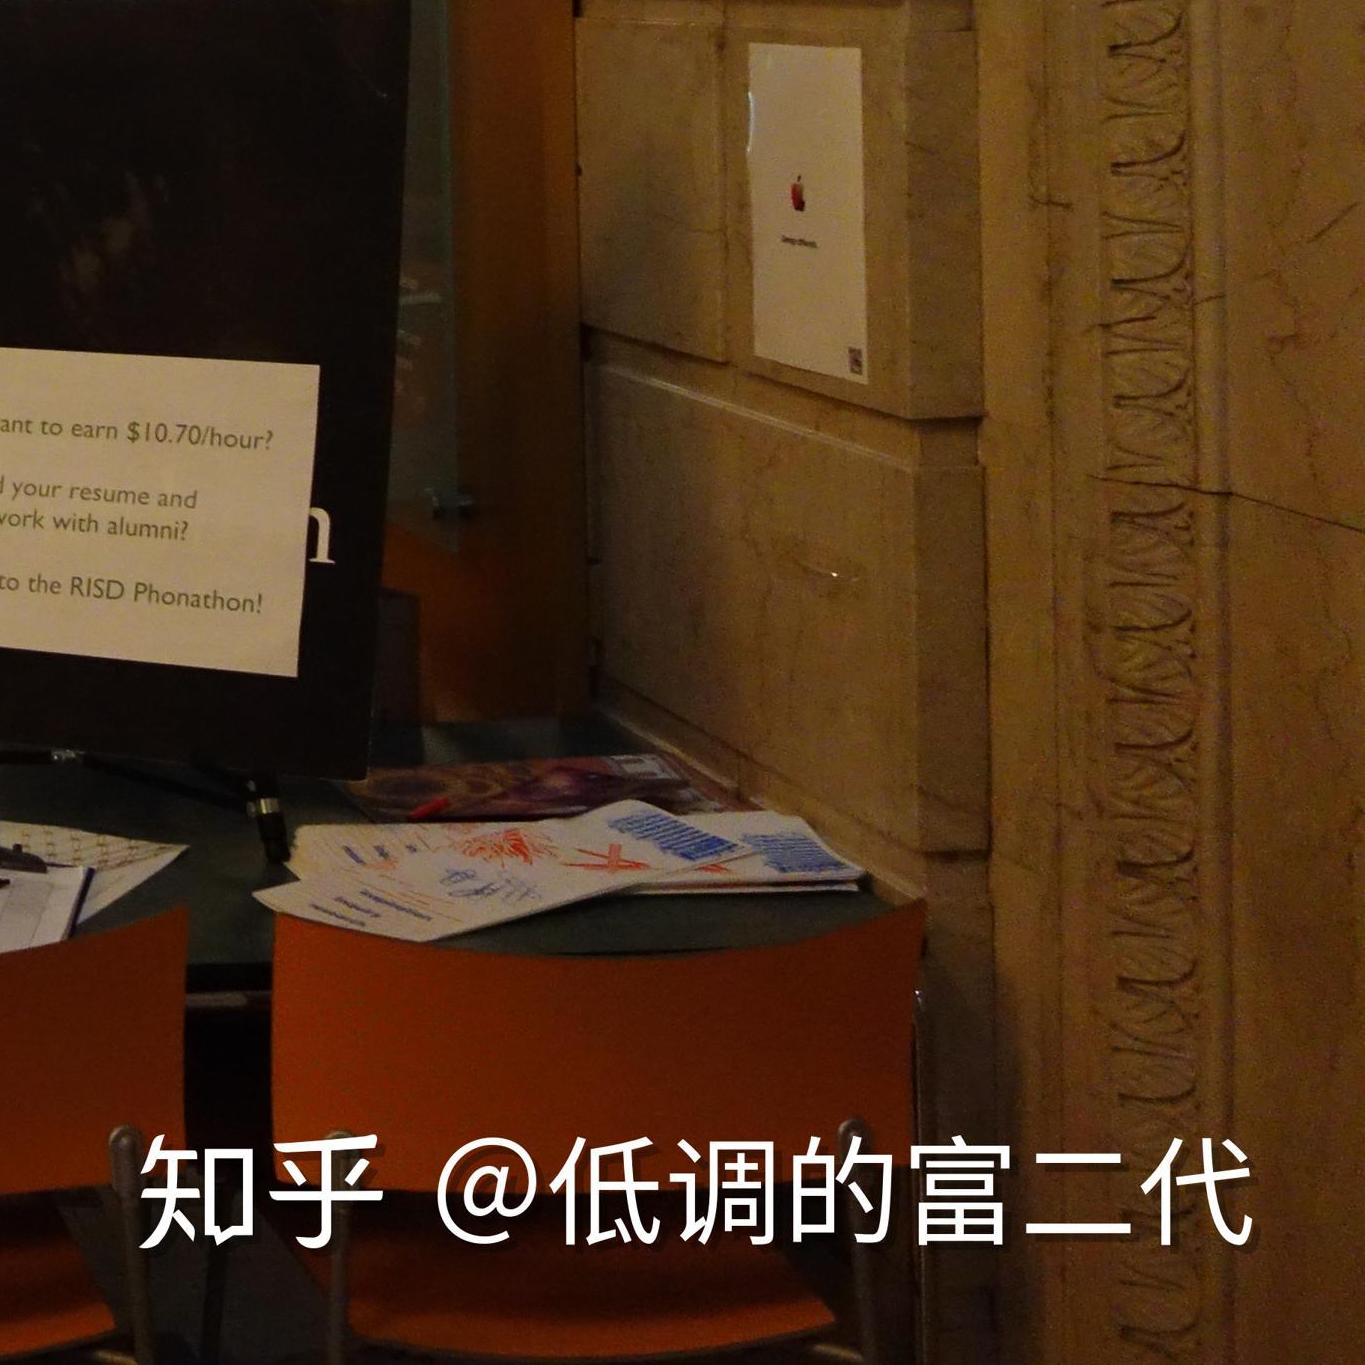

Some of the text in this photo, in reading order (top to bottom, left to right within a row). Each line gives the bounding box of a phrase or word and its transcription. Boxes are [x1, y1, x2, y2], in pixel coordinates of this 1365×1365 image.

[41, 418, 63, 436] to
[72, 422, 118, 440] earn
[127, 420, 273, 450] $10.70/hour?
[12, 480, 61, 500] your
[69, 485, 150, 506] resume
[157, 490, 197, 509] and
[53, 514, 99, 534] with
[107, 518, 189, 540] alumni?
[28, 574, 62, 595] the
[70, 576, 124, 600] RISD
[133, 582, 263, 614] Phonathon!
